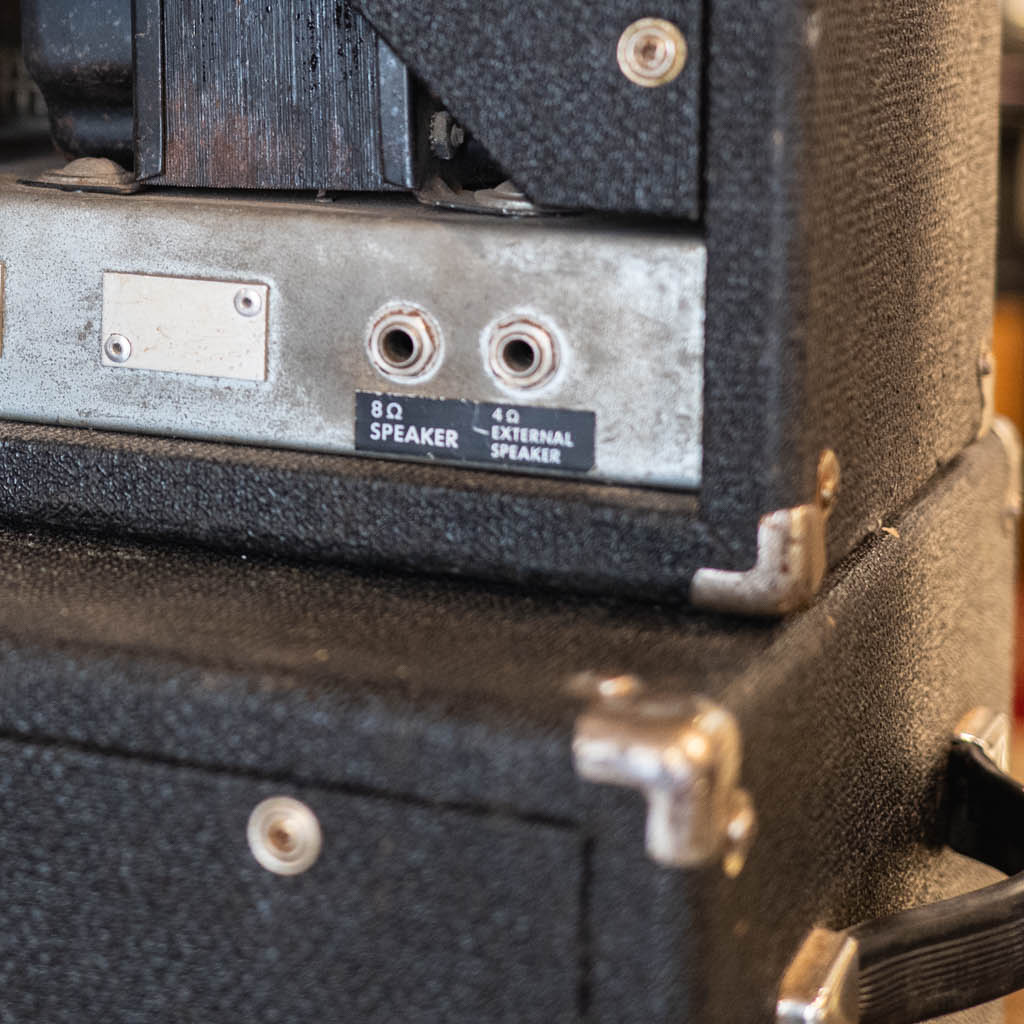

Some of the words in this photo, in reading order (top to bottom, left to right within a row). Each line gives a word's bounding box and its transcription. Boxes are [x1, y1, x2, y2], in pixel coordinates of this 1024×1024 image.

[370, 422, 459, 449] SPEAKER
[490, 425, 575, 448] EXTERNAL
[490, 443, 562, 464] SPEAKER
